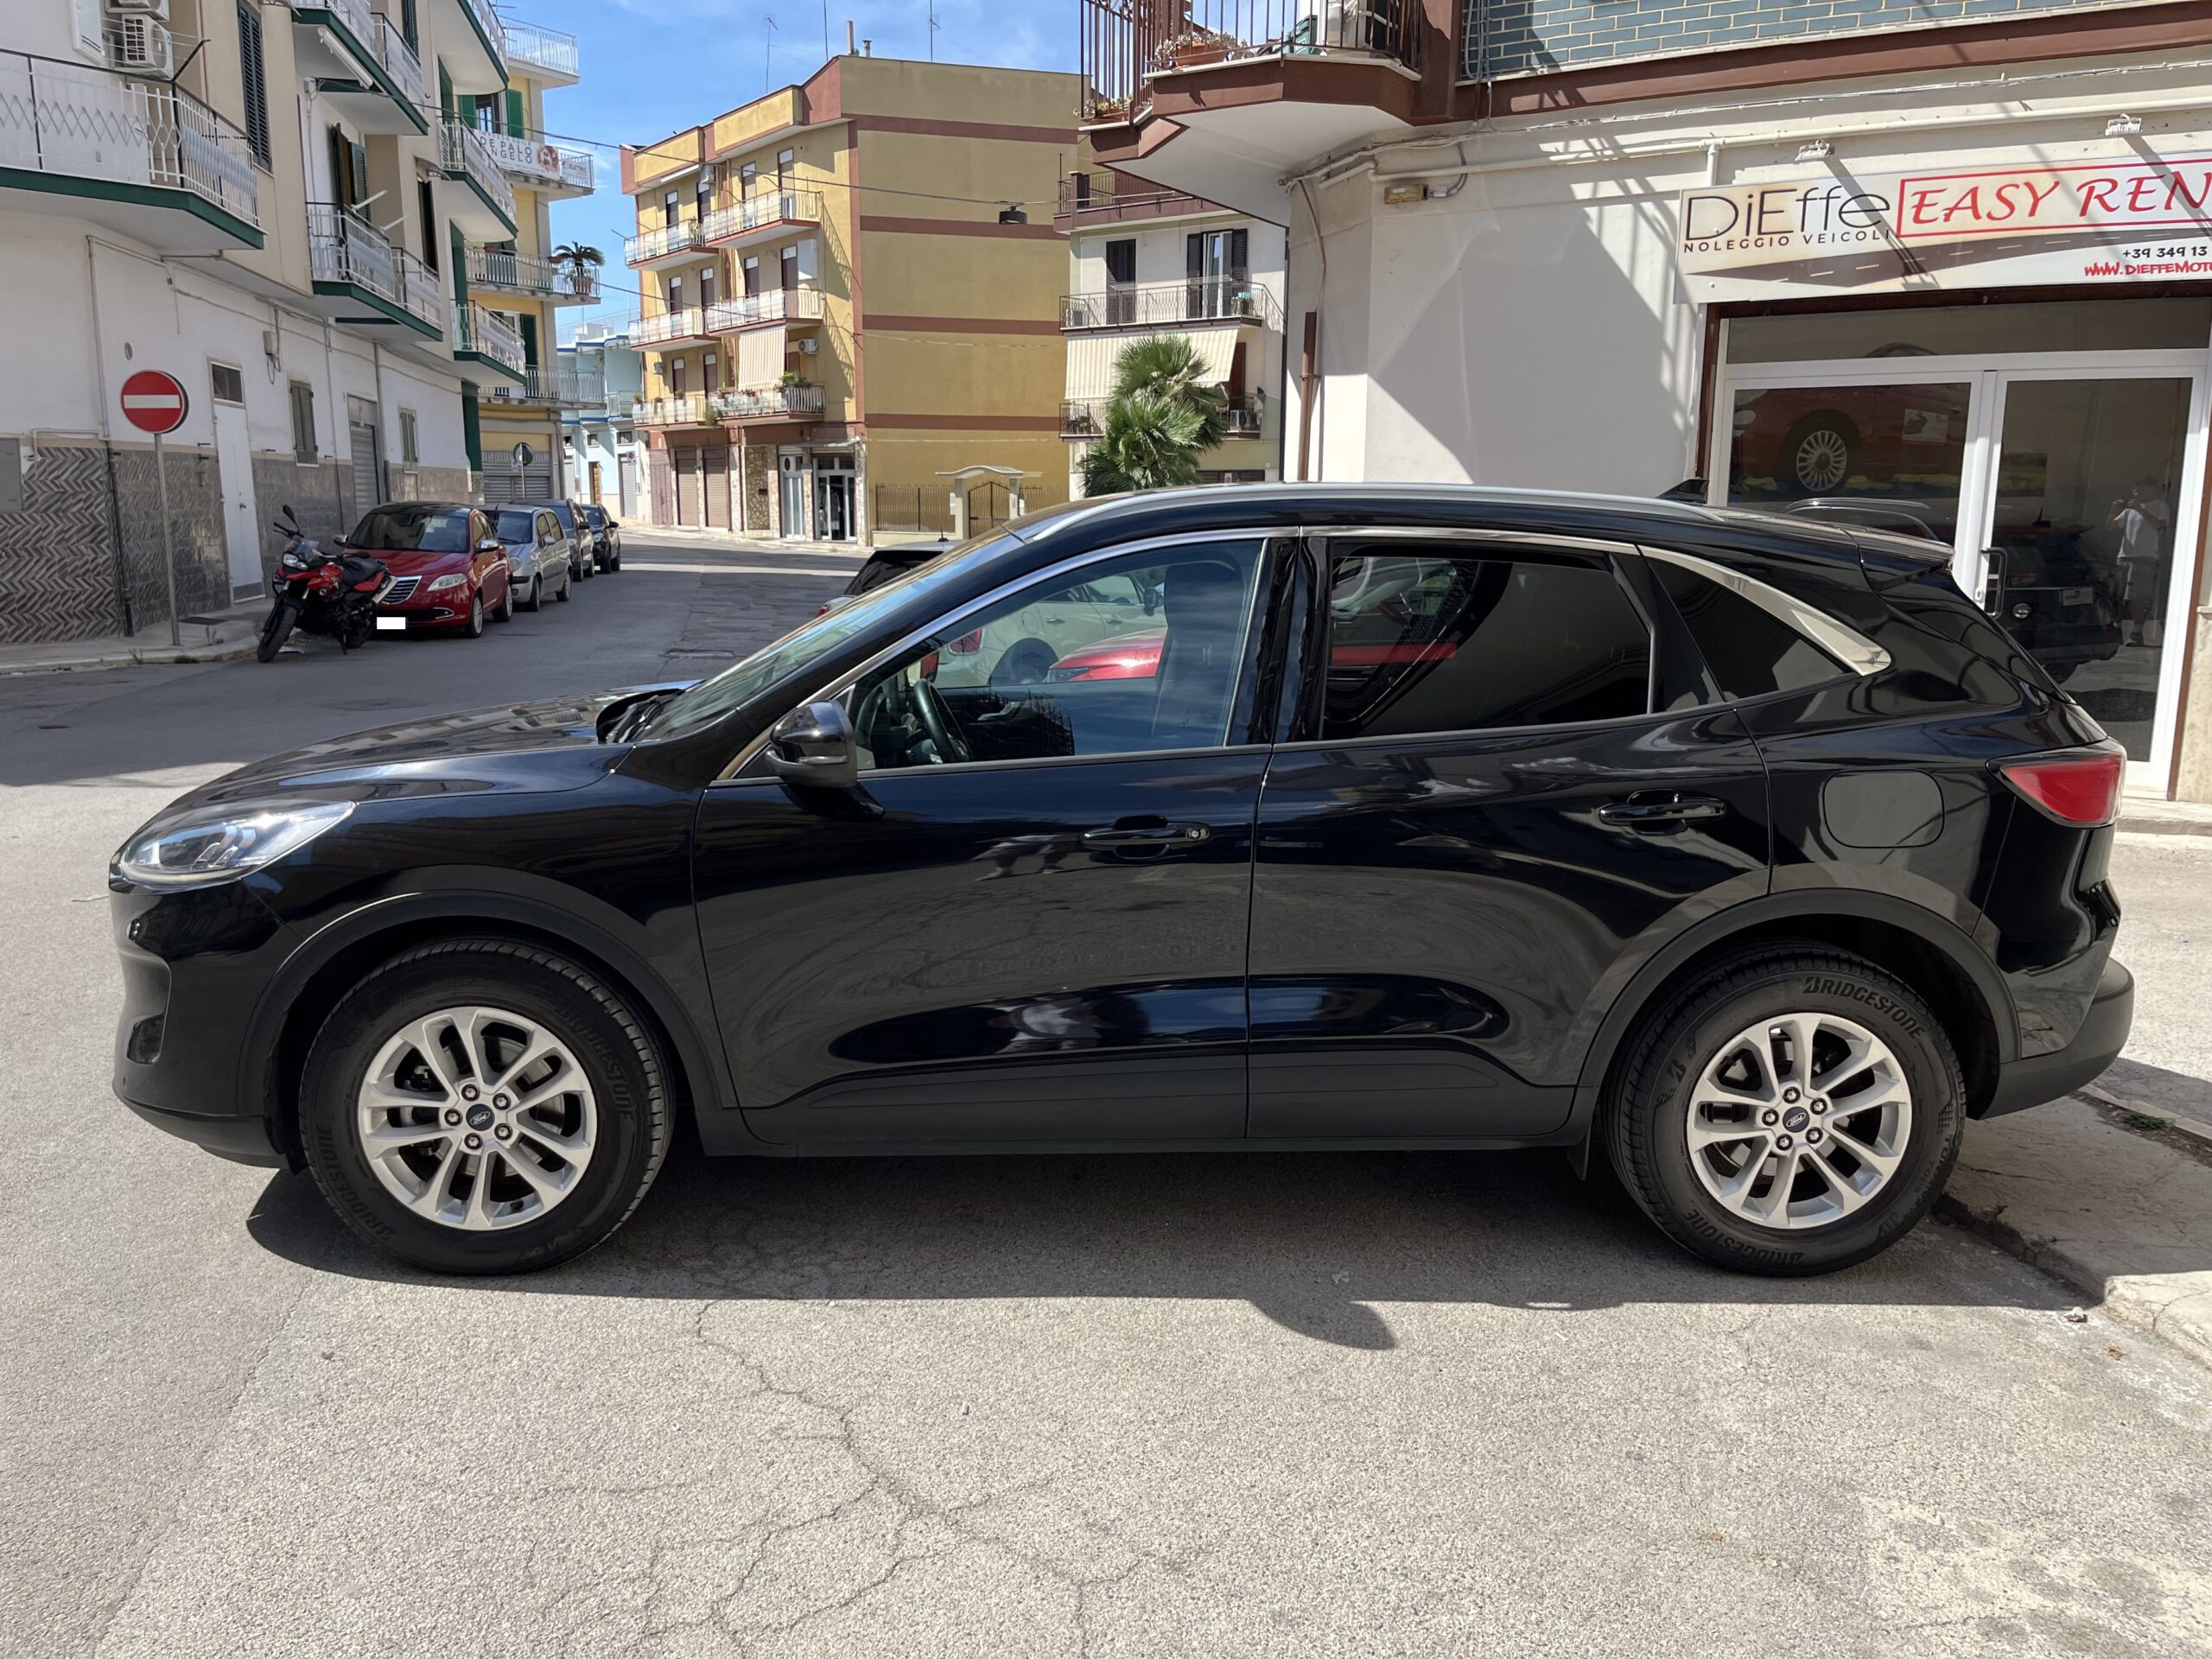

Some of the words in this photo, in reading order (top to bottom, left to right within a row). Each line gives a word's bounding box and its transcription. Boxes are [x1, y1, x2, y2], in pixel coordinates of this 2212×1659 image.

[480, 136, 495, 148] DE
[500, 141, 532, 156] PALO
[491, 148, 532, 164] NGELO
[1686, 185, 1891, 240] DiEffe
[1910, 181, 2060, 225] EASY
[1684, 236, 1789, 253] NOLEGGIO
[1803, 229, 1890, 245] VEICOLI
[2123, 248, 2151, 258] +39
[2157, 246, 2186, 257] 349
[1802, 976, 1925, 1039] BRIDGESTONE
[1681, 1209, 1805, 1266] BRIDGESTONE
